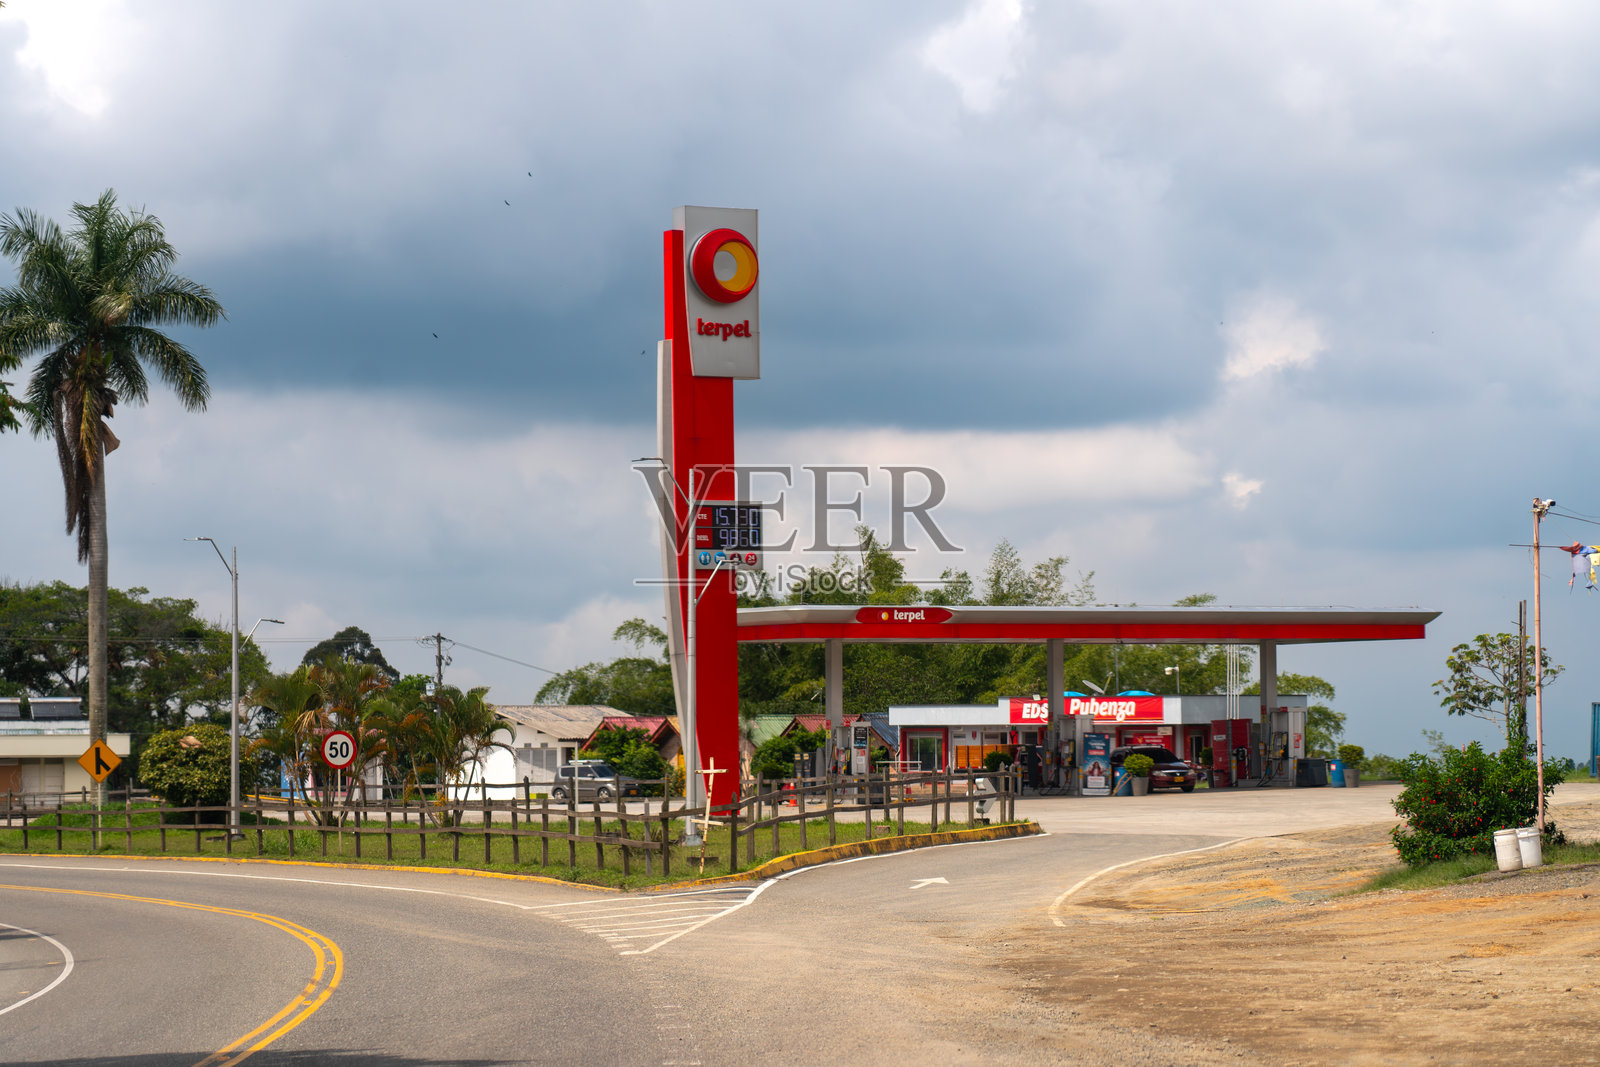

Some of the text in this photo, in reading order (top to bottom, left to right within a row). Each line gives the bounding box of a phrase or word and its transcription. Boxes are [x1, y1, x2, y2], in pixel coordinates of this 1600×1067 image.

[697, 317, 752, 341] terpel
[893, 609, 925, 623] terpel
[1022, 698, 1136, 722] EDS Pubenza
[328, 741, 350, 759] 50
